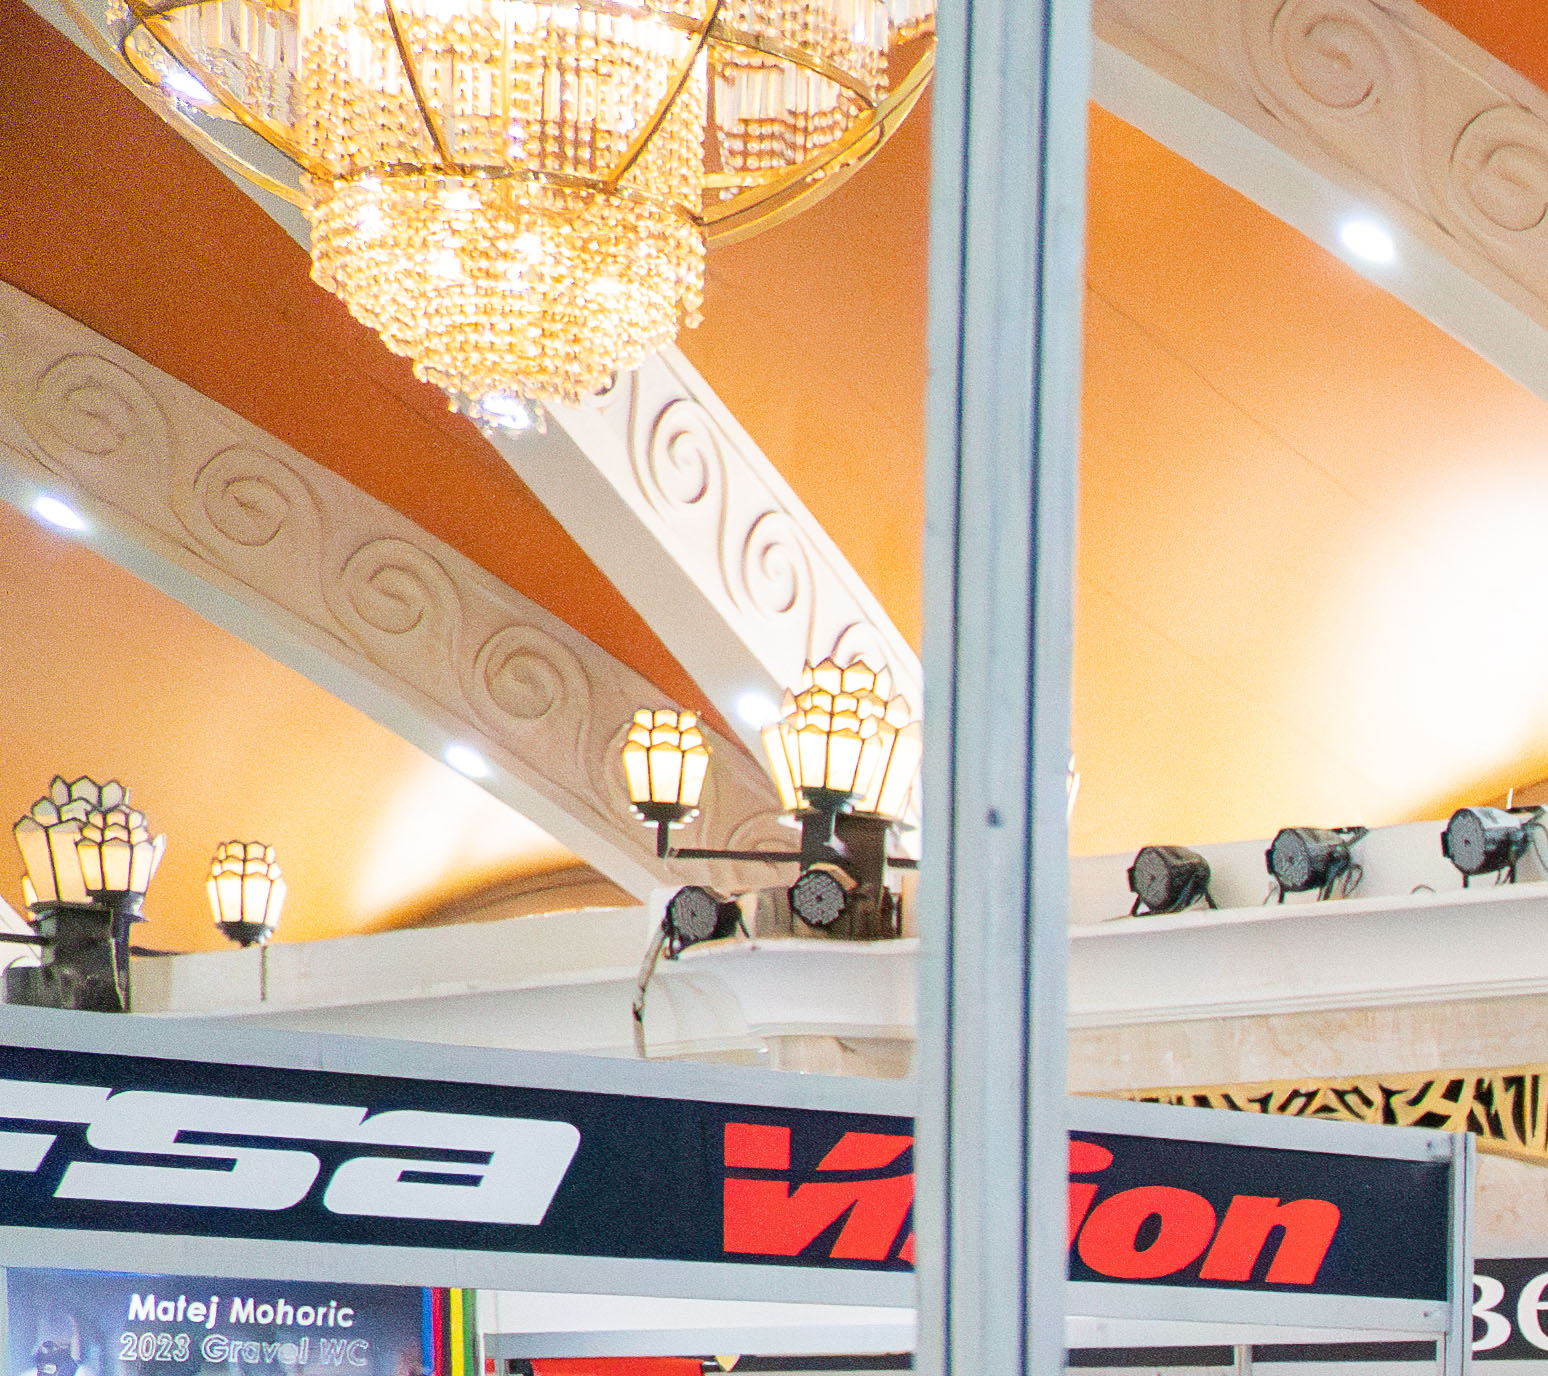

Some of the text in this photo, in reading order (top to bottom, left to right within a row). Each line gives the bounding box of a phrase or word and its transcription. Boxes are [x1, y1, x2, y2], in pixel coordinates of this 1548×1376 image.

[128, 1293, 355, 1329] Matej Mohoric
[118, 1333, 369, 1366] 2023 Gravel WC
